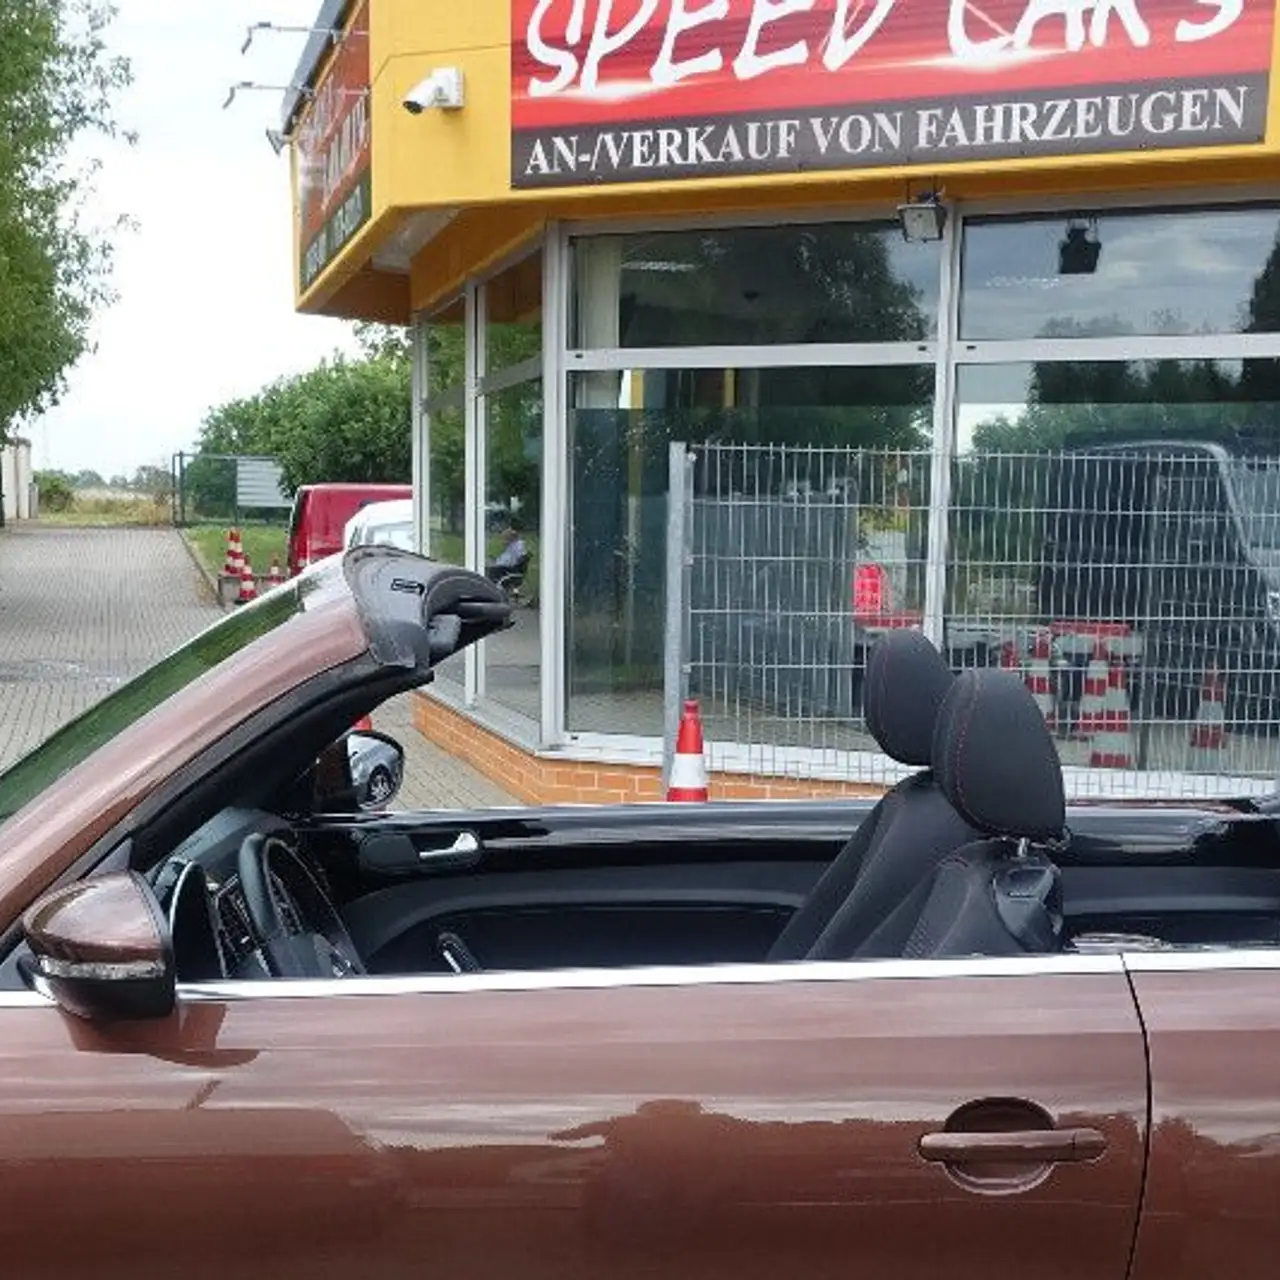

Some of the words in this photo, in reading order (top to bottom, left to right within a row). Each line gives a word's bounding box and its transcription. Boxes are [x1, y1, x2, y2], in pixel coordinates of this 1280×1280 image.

[527, 0, 898, 98] SPEED
[525, 120, 800, 175] AN-/VERKAUF
[810, 111, 903, 155] VON
[916, 85, 1249, 148] FAHRZEUGEN
